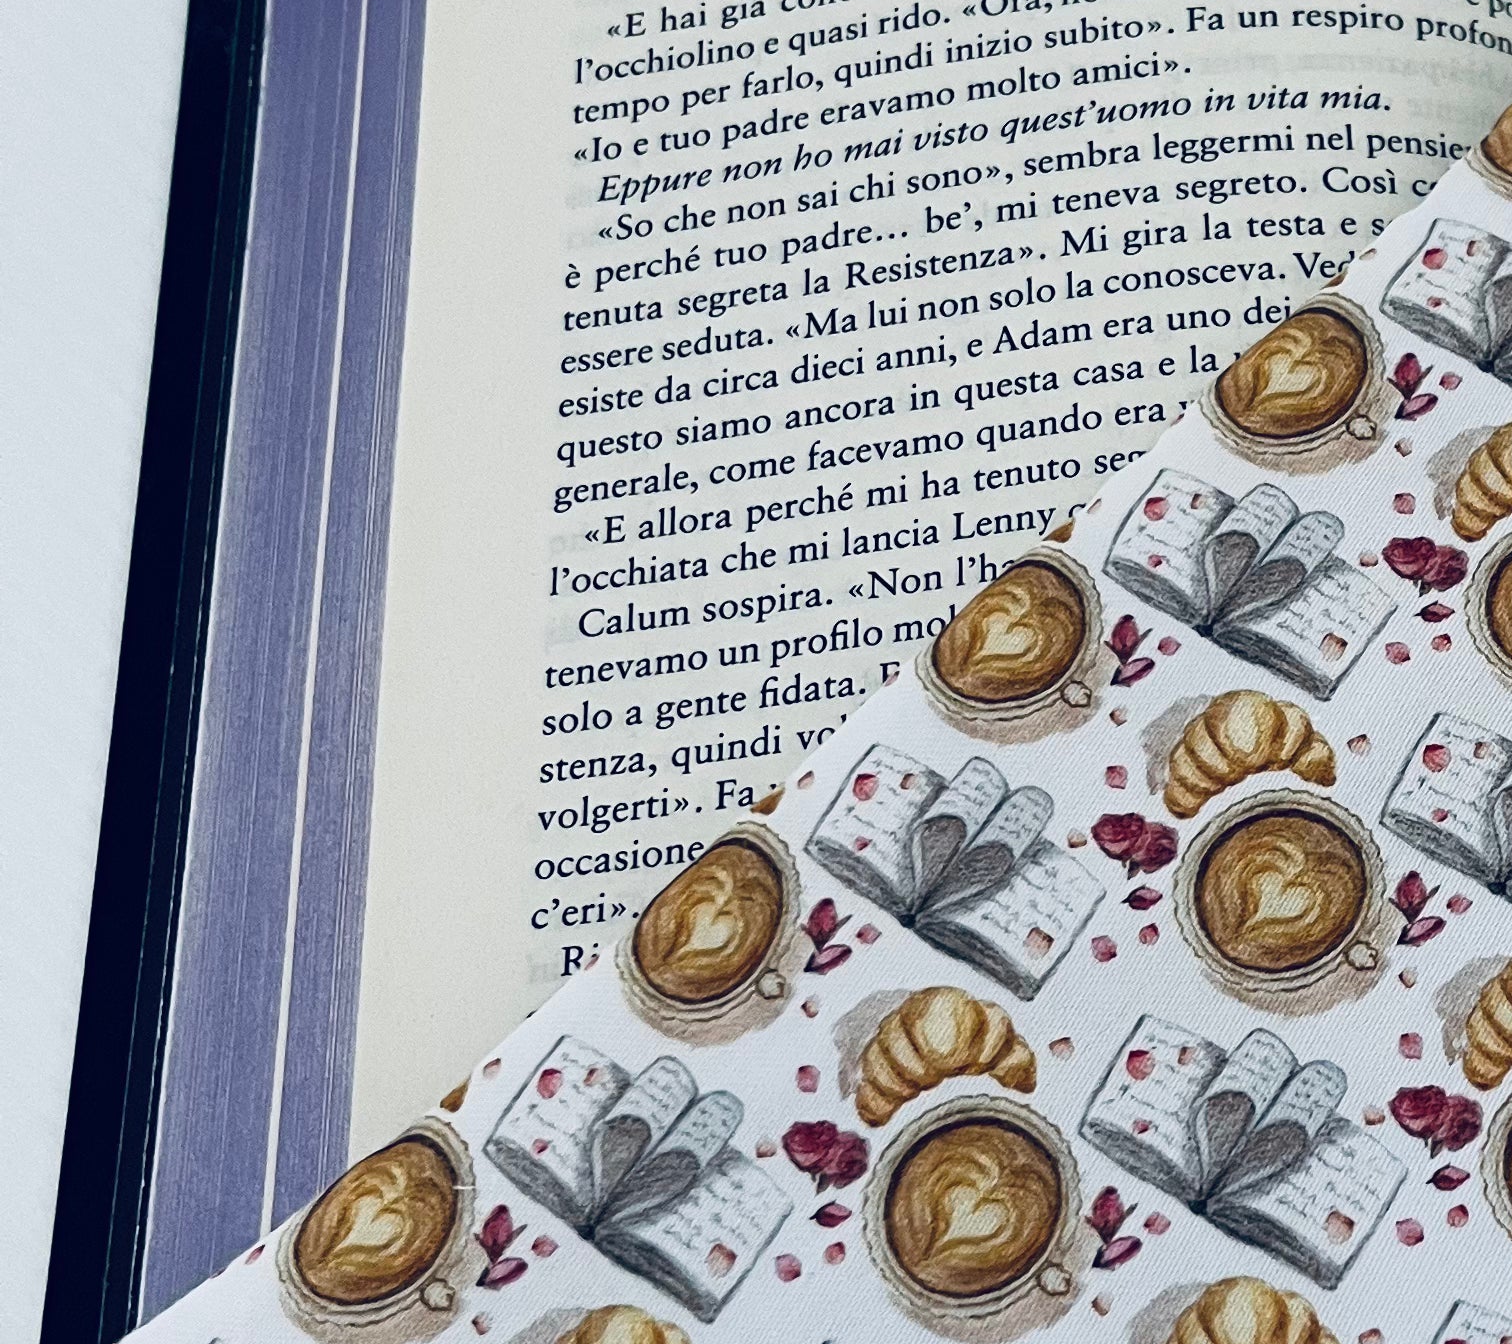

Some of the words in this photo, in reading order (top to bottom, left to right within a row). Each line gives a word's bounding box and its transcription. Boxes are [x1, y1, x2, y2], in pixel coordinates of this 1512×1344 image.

[596, 168, 713, 206] Eppure
[722, 156, 783, 184] non
[793, 142, 833, 172] ho
[843, 127, 904, 164] mai
[913, 122, 989, 152] visto
[1204, 87, 1236, 114] in
[1246, 84, 1309, 111] vita
[1320, 83, 1392, 112] mia.
[564, 263, 581, 290] è
[593, 244, 701, 294] perché
[713, 243, 768, 268] tuo
[995, 191, 1039, 223] mi
[1051, 184, 1161, 215] teneva
[1175, 173, 1307, 205] segreto.
[1321, 165, 1400, 196] Così
[558, 386, 644, 418] esiste
[654, 374, 692, 405] da
[702, 367, 780, 398] circa
[790, 346, 865, 385] dieci
[875, 334, 958, 372] anni,
[966, 338, 984, 358] e
[992, 318, 1094, 355] Adam
[1102, 315, 1155, 339] era
[1165, 308, 1232, 332] uno
[1242, 294, 1292, 326] dei
[720, 540, 777, 574] che
[787, 531, 830, 566] mi
[841, 518, 941, 558] lancia
[951, 501, 1058, 541] Lenny
[544, 650, 708, 689] tenevamo
[718, 643, 761, 667] un
[769, 617, 883, 669] profilo
[539, 752, 658, 784] stenza,
[670, 724, 782, 775] quindi
